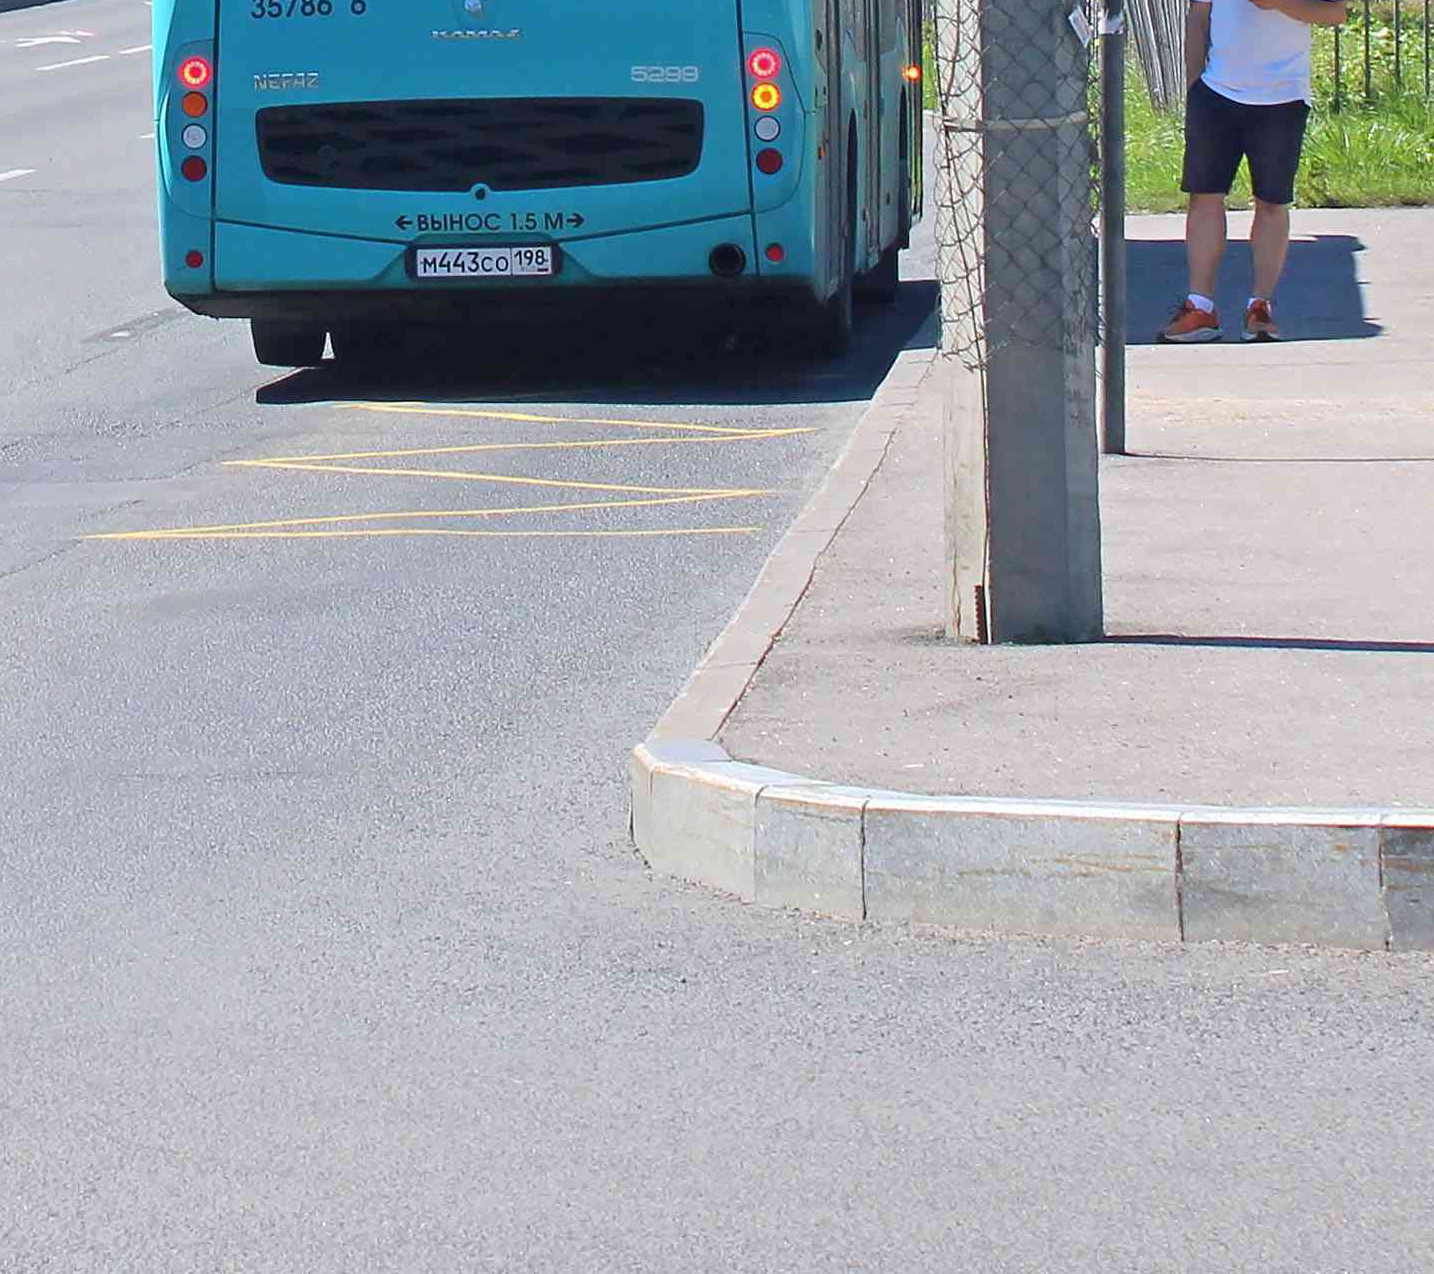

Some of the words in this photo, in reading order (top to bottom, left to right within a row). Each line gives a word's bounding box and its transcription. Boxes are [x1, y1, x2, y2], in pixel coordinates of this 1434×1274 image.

[253, 72, 319, 90] NEFAZ
[630, 66, 699, 82] 5299
[417, 213, 501, 231] ВЫНОС
[510, 213, 537, 230] 1.5
[545, 212, 563, 230] М
